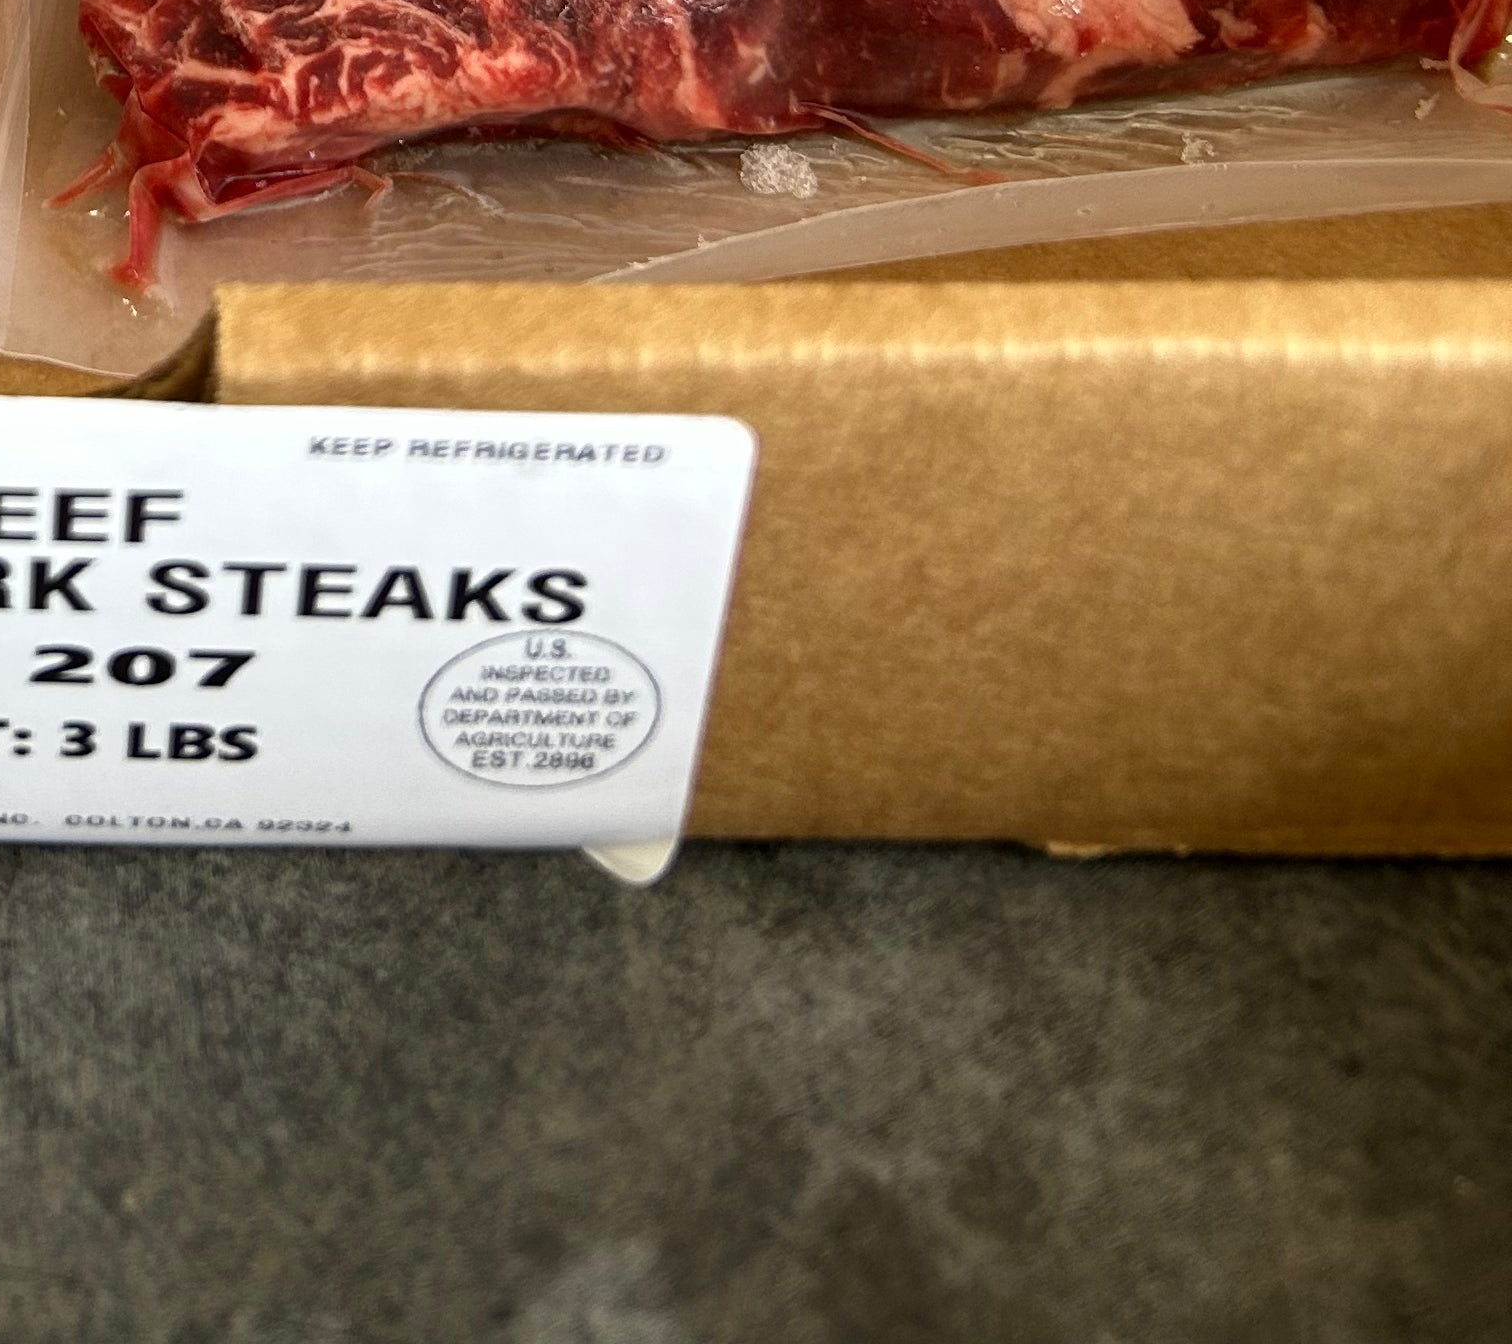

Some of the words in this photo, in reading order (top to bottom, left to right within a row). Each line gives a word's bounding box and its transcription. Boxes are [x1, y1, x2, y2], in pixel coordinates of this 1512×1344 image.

[308, 436, 394, 457] KEEP
[408, 439, 666, 463] REFRIGERATED
[144, 558, 590, 627] STEAKS
[524, 638, 571, 661] U.S.
[27, 644, 259, 691] 207
[481, 665, 610, 683] INSPECTED
[450, 686, 498, 703] AND
[504, 687, 597, 705] PASSED
[603, 688, 635, 706] BY
[442, 709, 596, 727] DEPARTMENT
[605, 710, 637, 728] OF
[58, 720, 99, 760] 3
[125, 721, 260, 765] LBS
[455, 731, 616, 750] AGRICULTURE
[257, 820, 352, 834] 92324
